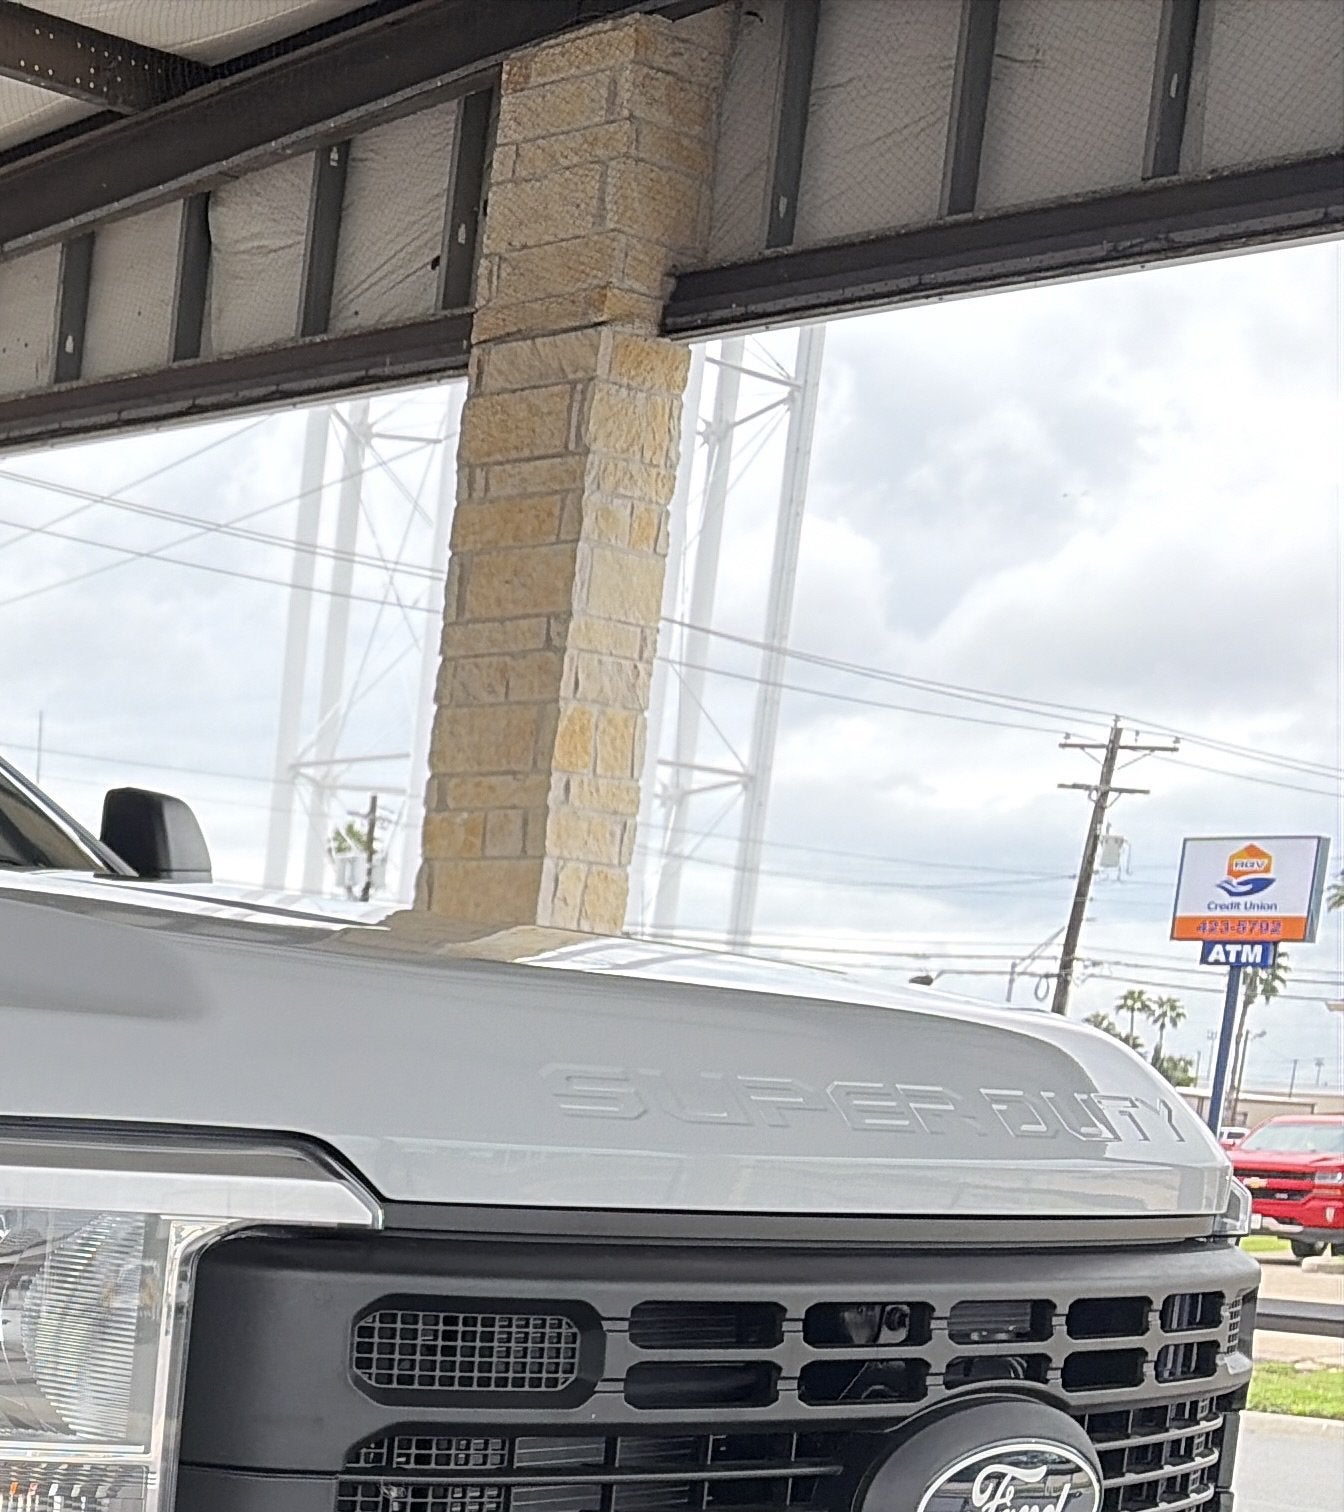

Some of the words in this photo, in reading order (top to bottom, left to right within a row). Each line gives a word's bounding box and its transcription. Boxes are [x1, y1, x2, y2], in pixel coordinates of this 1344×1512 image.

[1207, 900, 1241, 911] Credit
[1244, 900, 1278, 911] Union
[1208, 944, 1263, 963] ATM
[538, 1062, 988, 1137] SUPER
[979, 1088, 1186, 1143] DUTY
